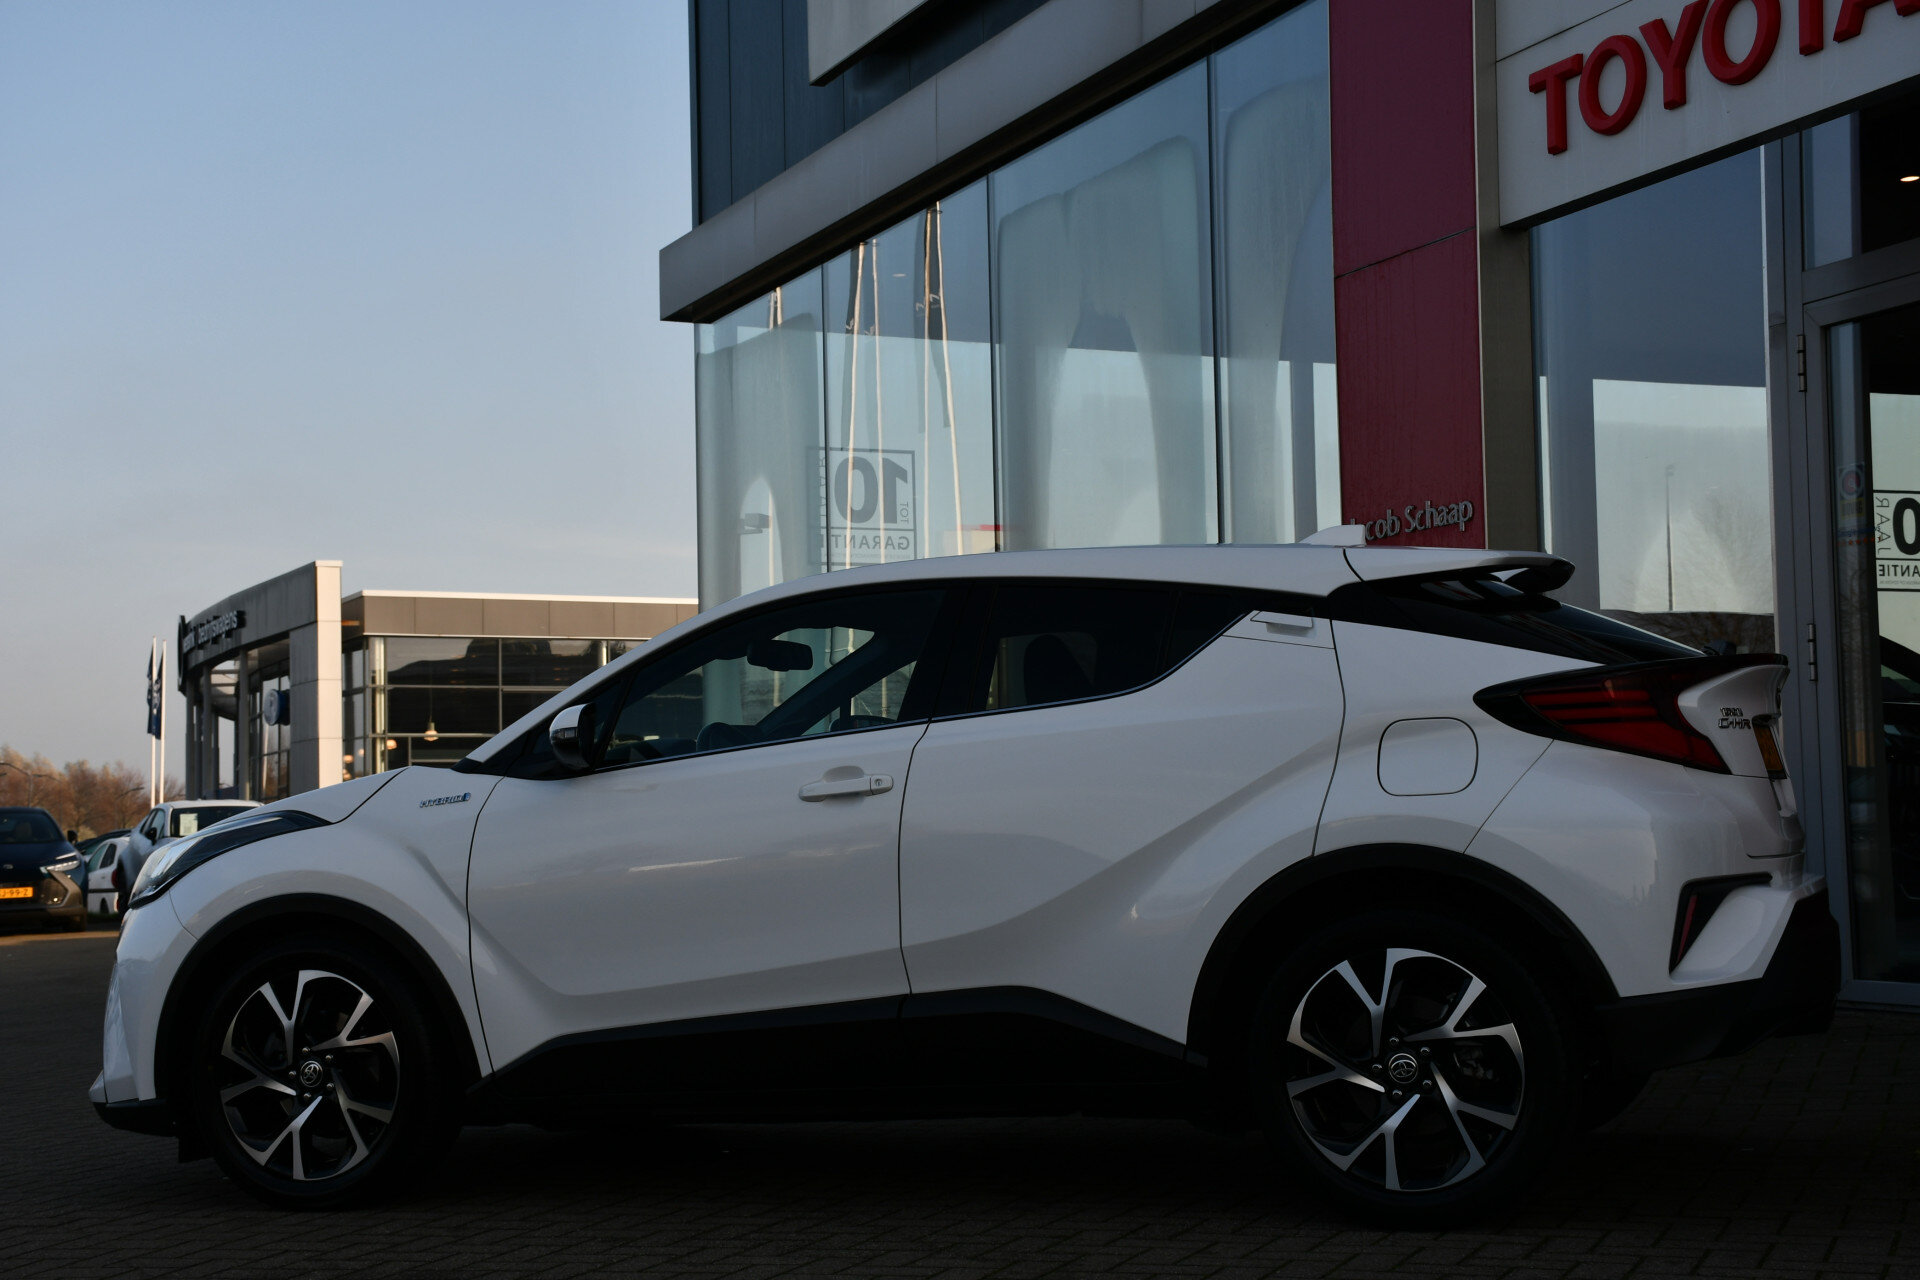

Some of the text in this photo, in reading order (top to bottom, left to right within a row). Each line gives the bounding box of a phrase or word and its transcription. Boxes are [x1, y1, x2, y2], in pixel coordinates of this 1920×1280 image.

[1404, 500, 1474, 533] Schaap
[1718, 718, 1752, 730] C-HR
[0, 888, 29, 898] J-99-Z
